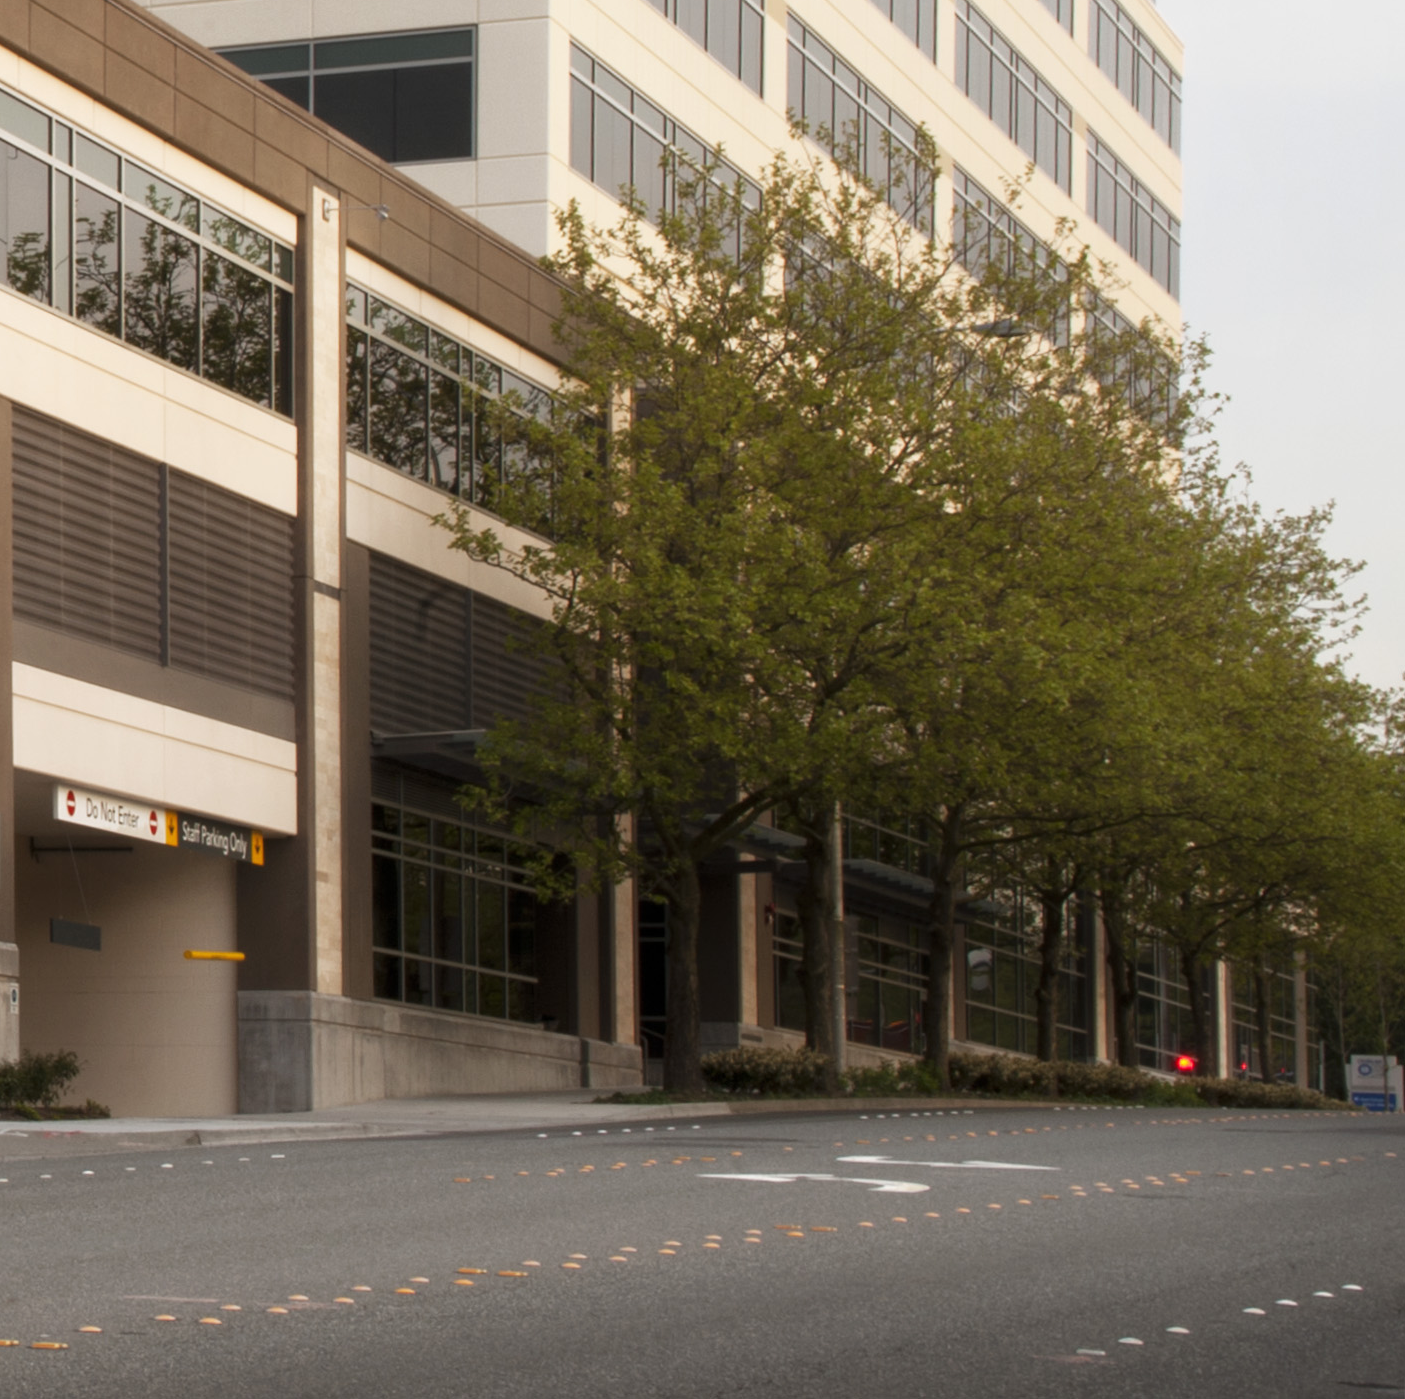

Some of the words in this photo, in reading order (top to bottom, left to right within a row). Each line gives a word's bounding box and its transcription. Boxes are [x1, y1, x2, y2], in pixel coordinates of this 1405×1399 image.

[86, 798, 98, 819] Do
[101, 802, 116, 824] Not
[119, 806, 140, 828] Enter
[182, 821, 200, 843] Staff
[201, 827, 229, 856] Parking
[230, 832, 248, 859] Only
